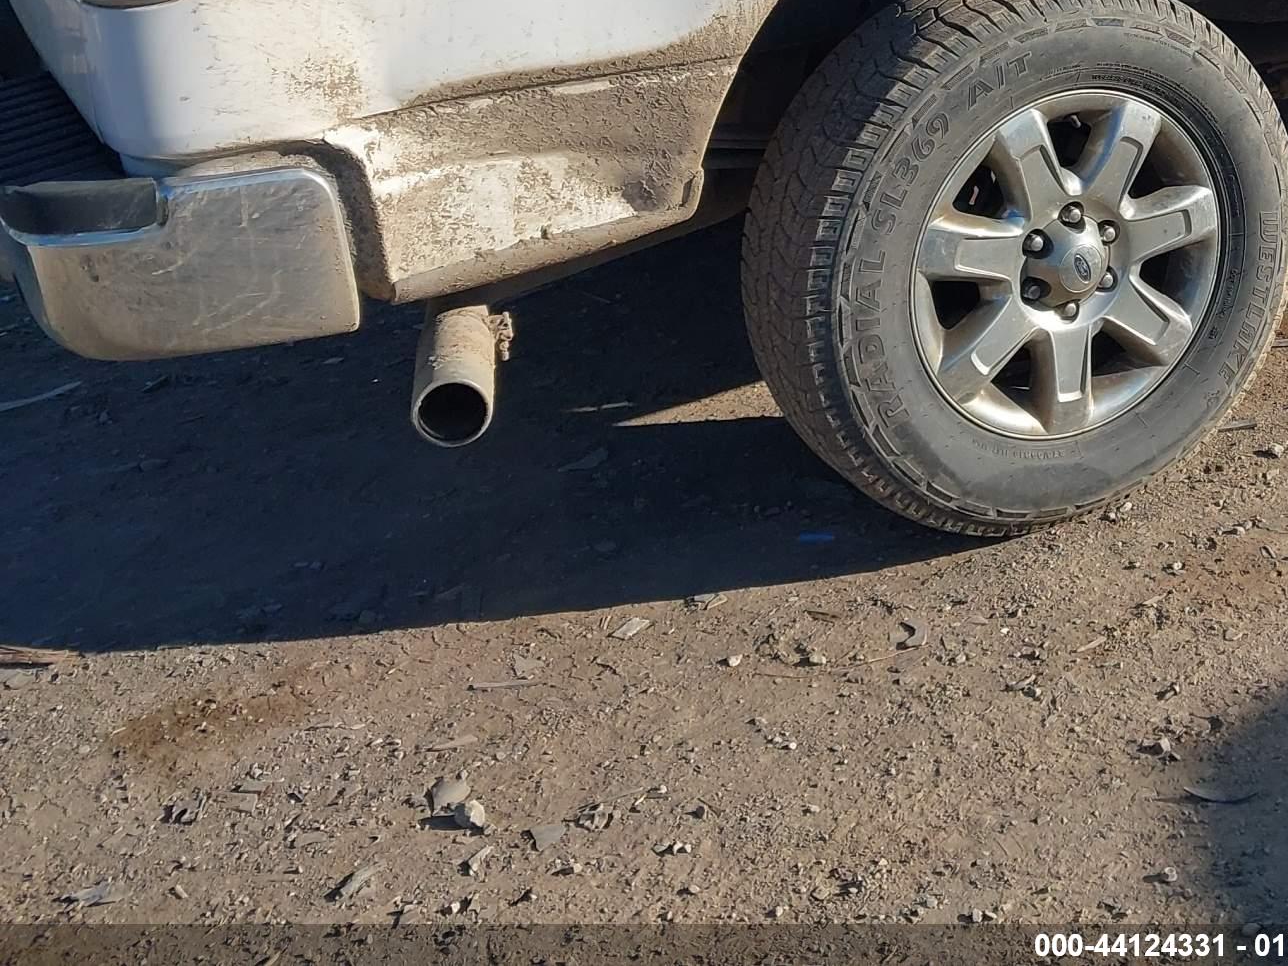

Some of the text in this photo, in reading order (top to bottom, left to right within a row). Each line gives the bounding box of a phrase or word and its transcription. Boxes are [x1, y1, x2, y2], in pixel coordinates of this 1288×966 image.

[855, 51, 1032, 428] RADIAL SL369 A/T
[1219, 211, 1280, 385] WESTLAKE
